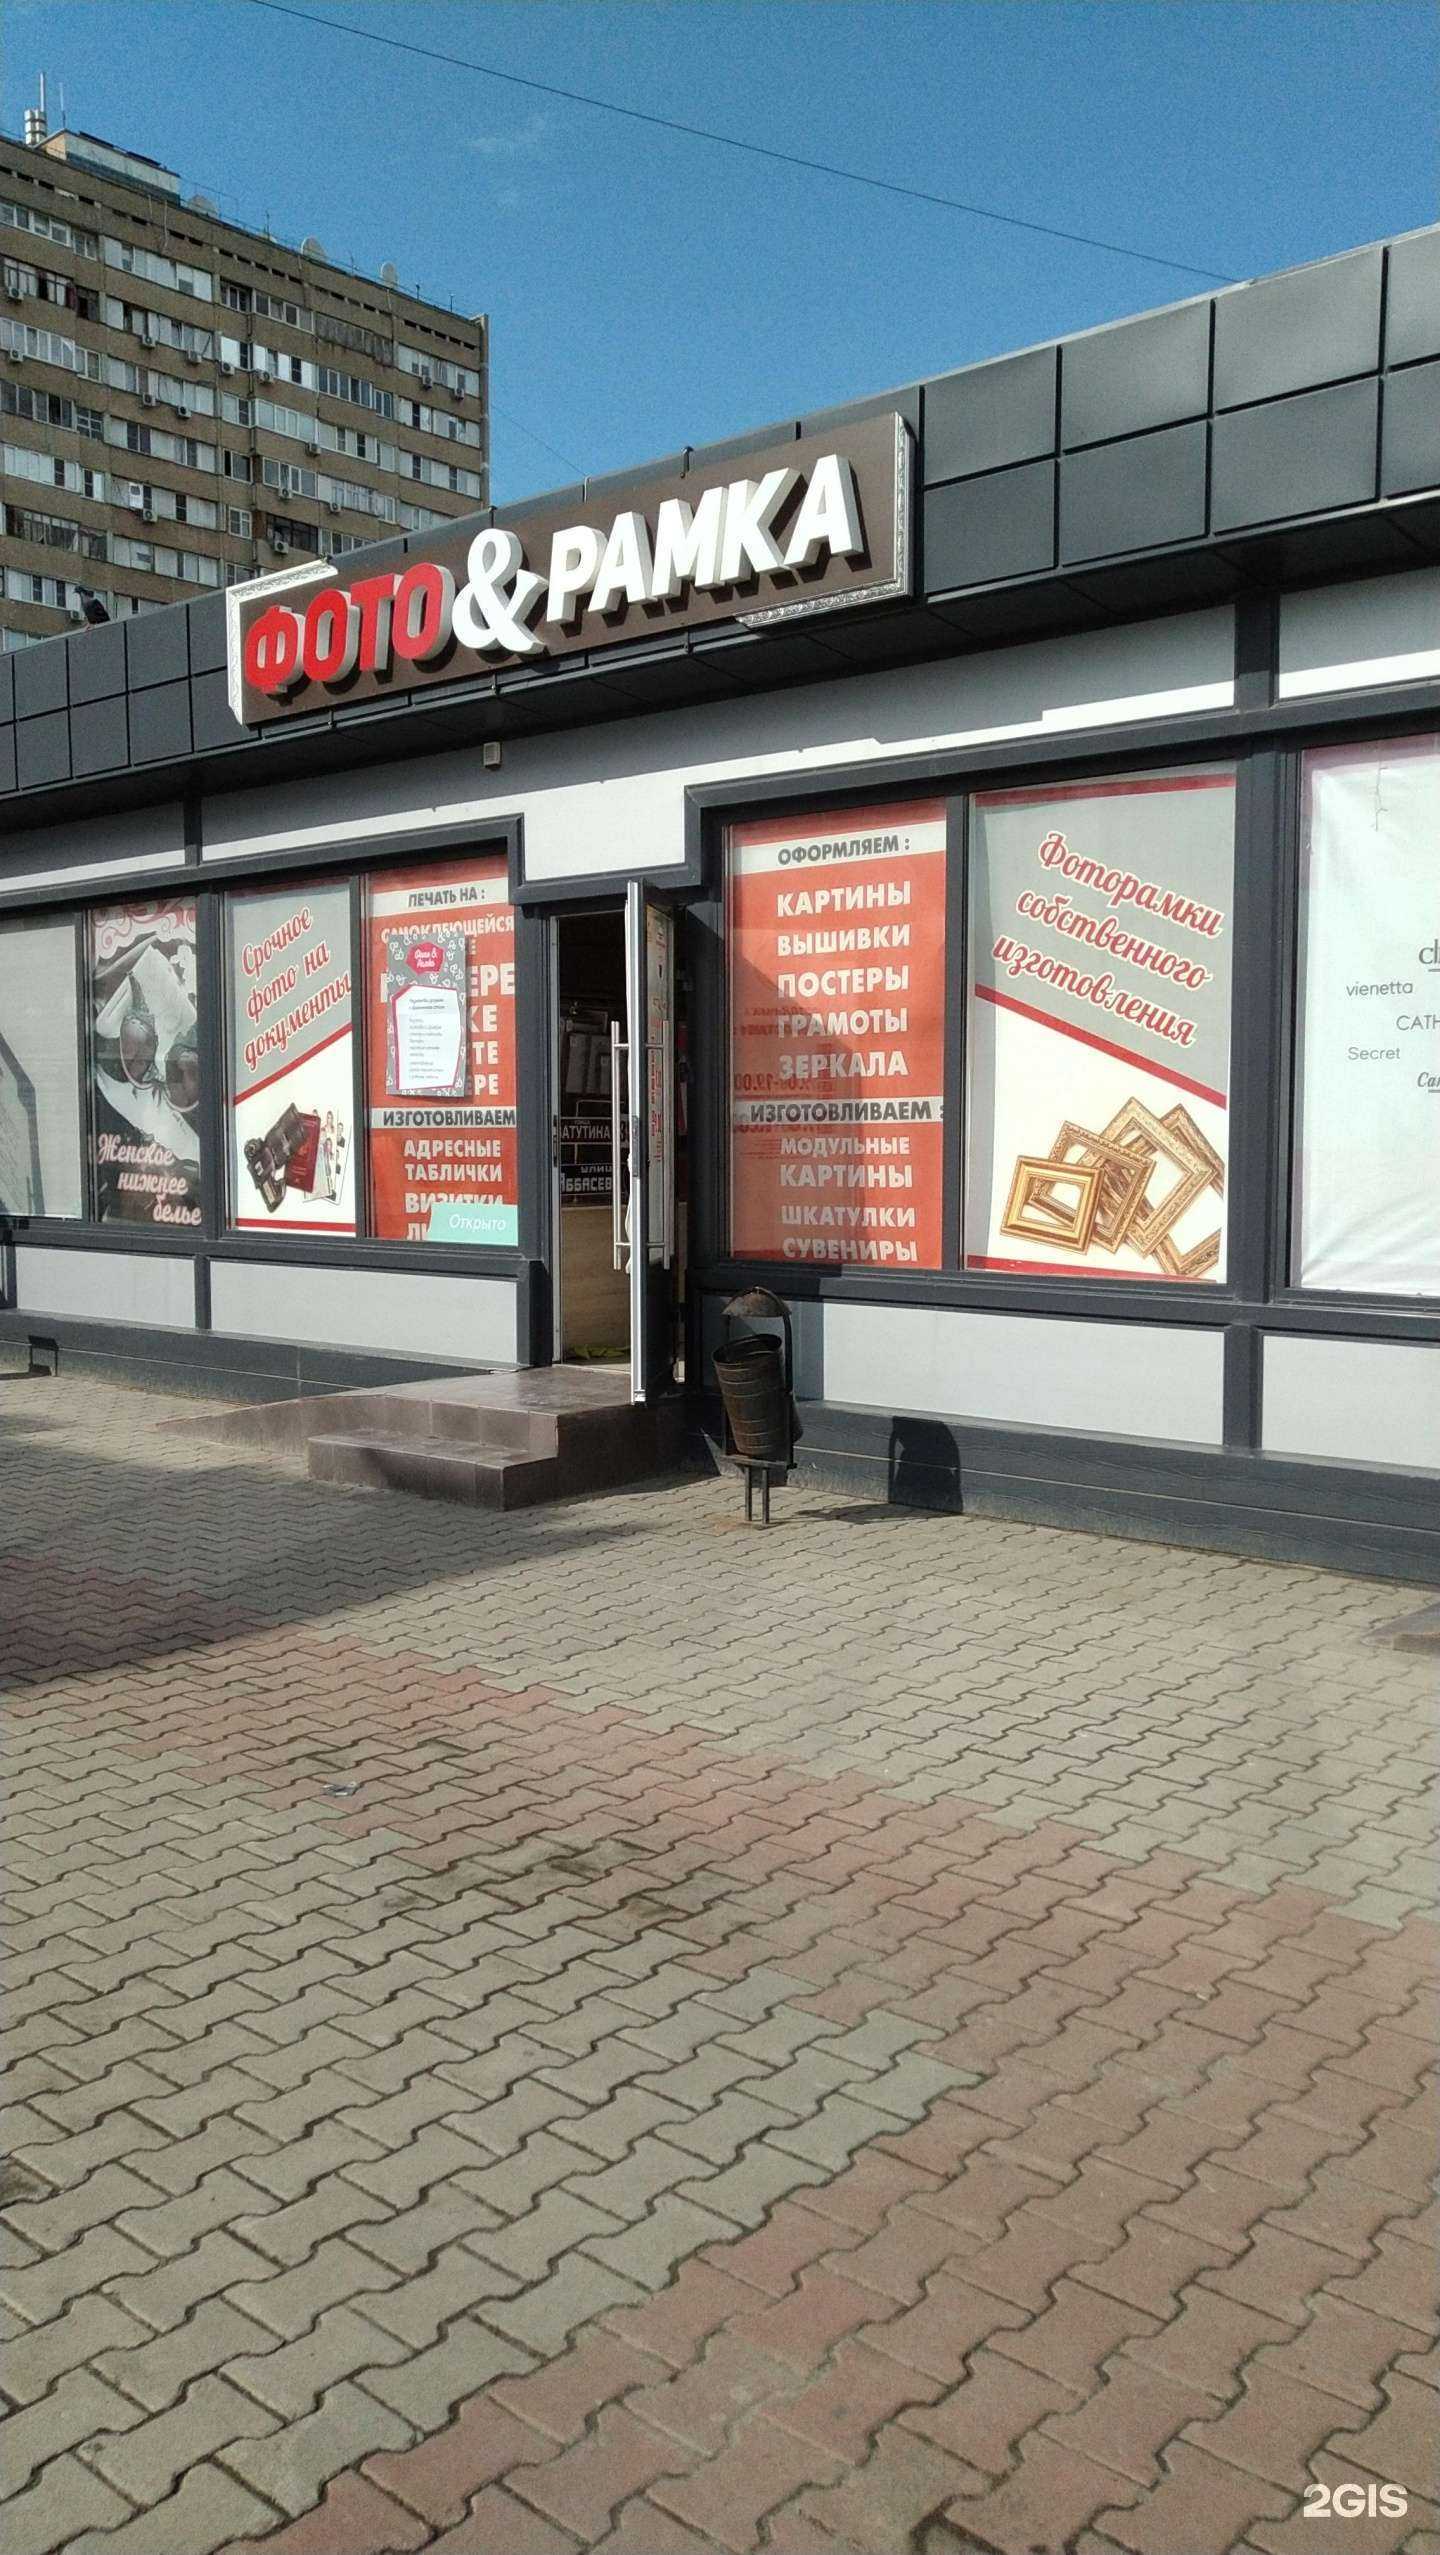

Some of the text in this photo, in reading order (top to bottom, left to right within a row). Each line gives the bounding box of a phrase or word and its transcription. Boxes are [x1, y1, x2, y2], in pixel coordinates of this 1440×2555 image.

[777, 835, 899, 866] ОФОРМЛЯЕМ
[408, 889, 456, 907] ПЕЧАТЬ
[460, 887, 477, 900] НА
[1038, 832, 1223, 937] Фоторамки
[777, 880, 911, 917] КАРТИНЫ
[242, 907, 312, 979] Срочное
[777, 924, 910, 957] ВЫШИВКИ
[1017, 891, 1211, 988] собственного
[246, 942, 330, 1024] фото на
[778, 965, 909, 998] ПОСТЕРЫ
[991, 934, 1196, 1046] изготовления
[1346, 981, 1413, 996] vienetta
[244, 973, 351, 1072] документы
[777, 1007, 908, 1039] ГРАМОТЫ
[779, 1050, 909, 1079] ЗЕРКАЛА
[1348, 1047, 1400, 1060] Secret
[383, 1109, 516, 1127] ИЗГОТОВЛИВАЕМ
[750, 1101, 932, 1123] ИЗГОТОВЛИВАЕМ
[560, 1125, 611, 1139] АТУТИНА
[98, 1133, 175, 1166] Женское
[403, 1139, 501, 1159] АДРЕСНЫЕ
[780, 1137, 910, 1158] МОДУЛЬНЫЕ
[118, 1172, 188, 1195] нижнее
[404, 1163, 502, 1181] ТАБЛИЧКИ
[780, 1164, 913, 1188] КАРТИНЫ
[153, 1194, 202, 1226] белье
[449, 1214, 506, 1232] Открыто
[782, 1205, 915, 1228] ШКАТУЛКИ
[783, 1237, 918, 1262] СУВЕНИРЫ
